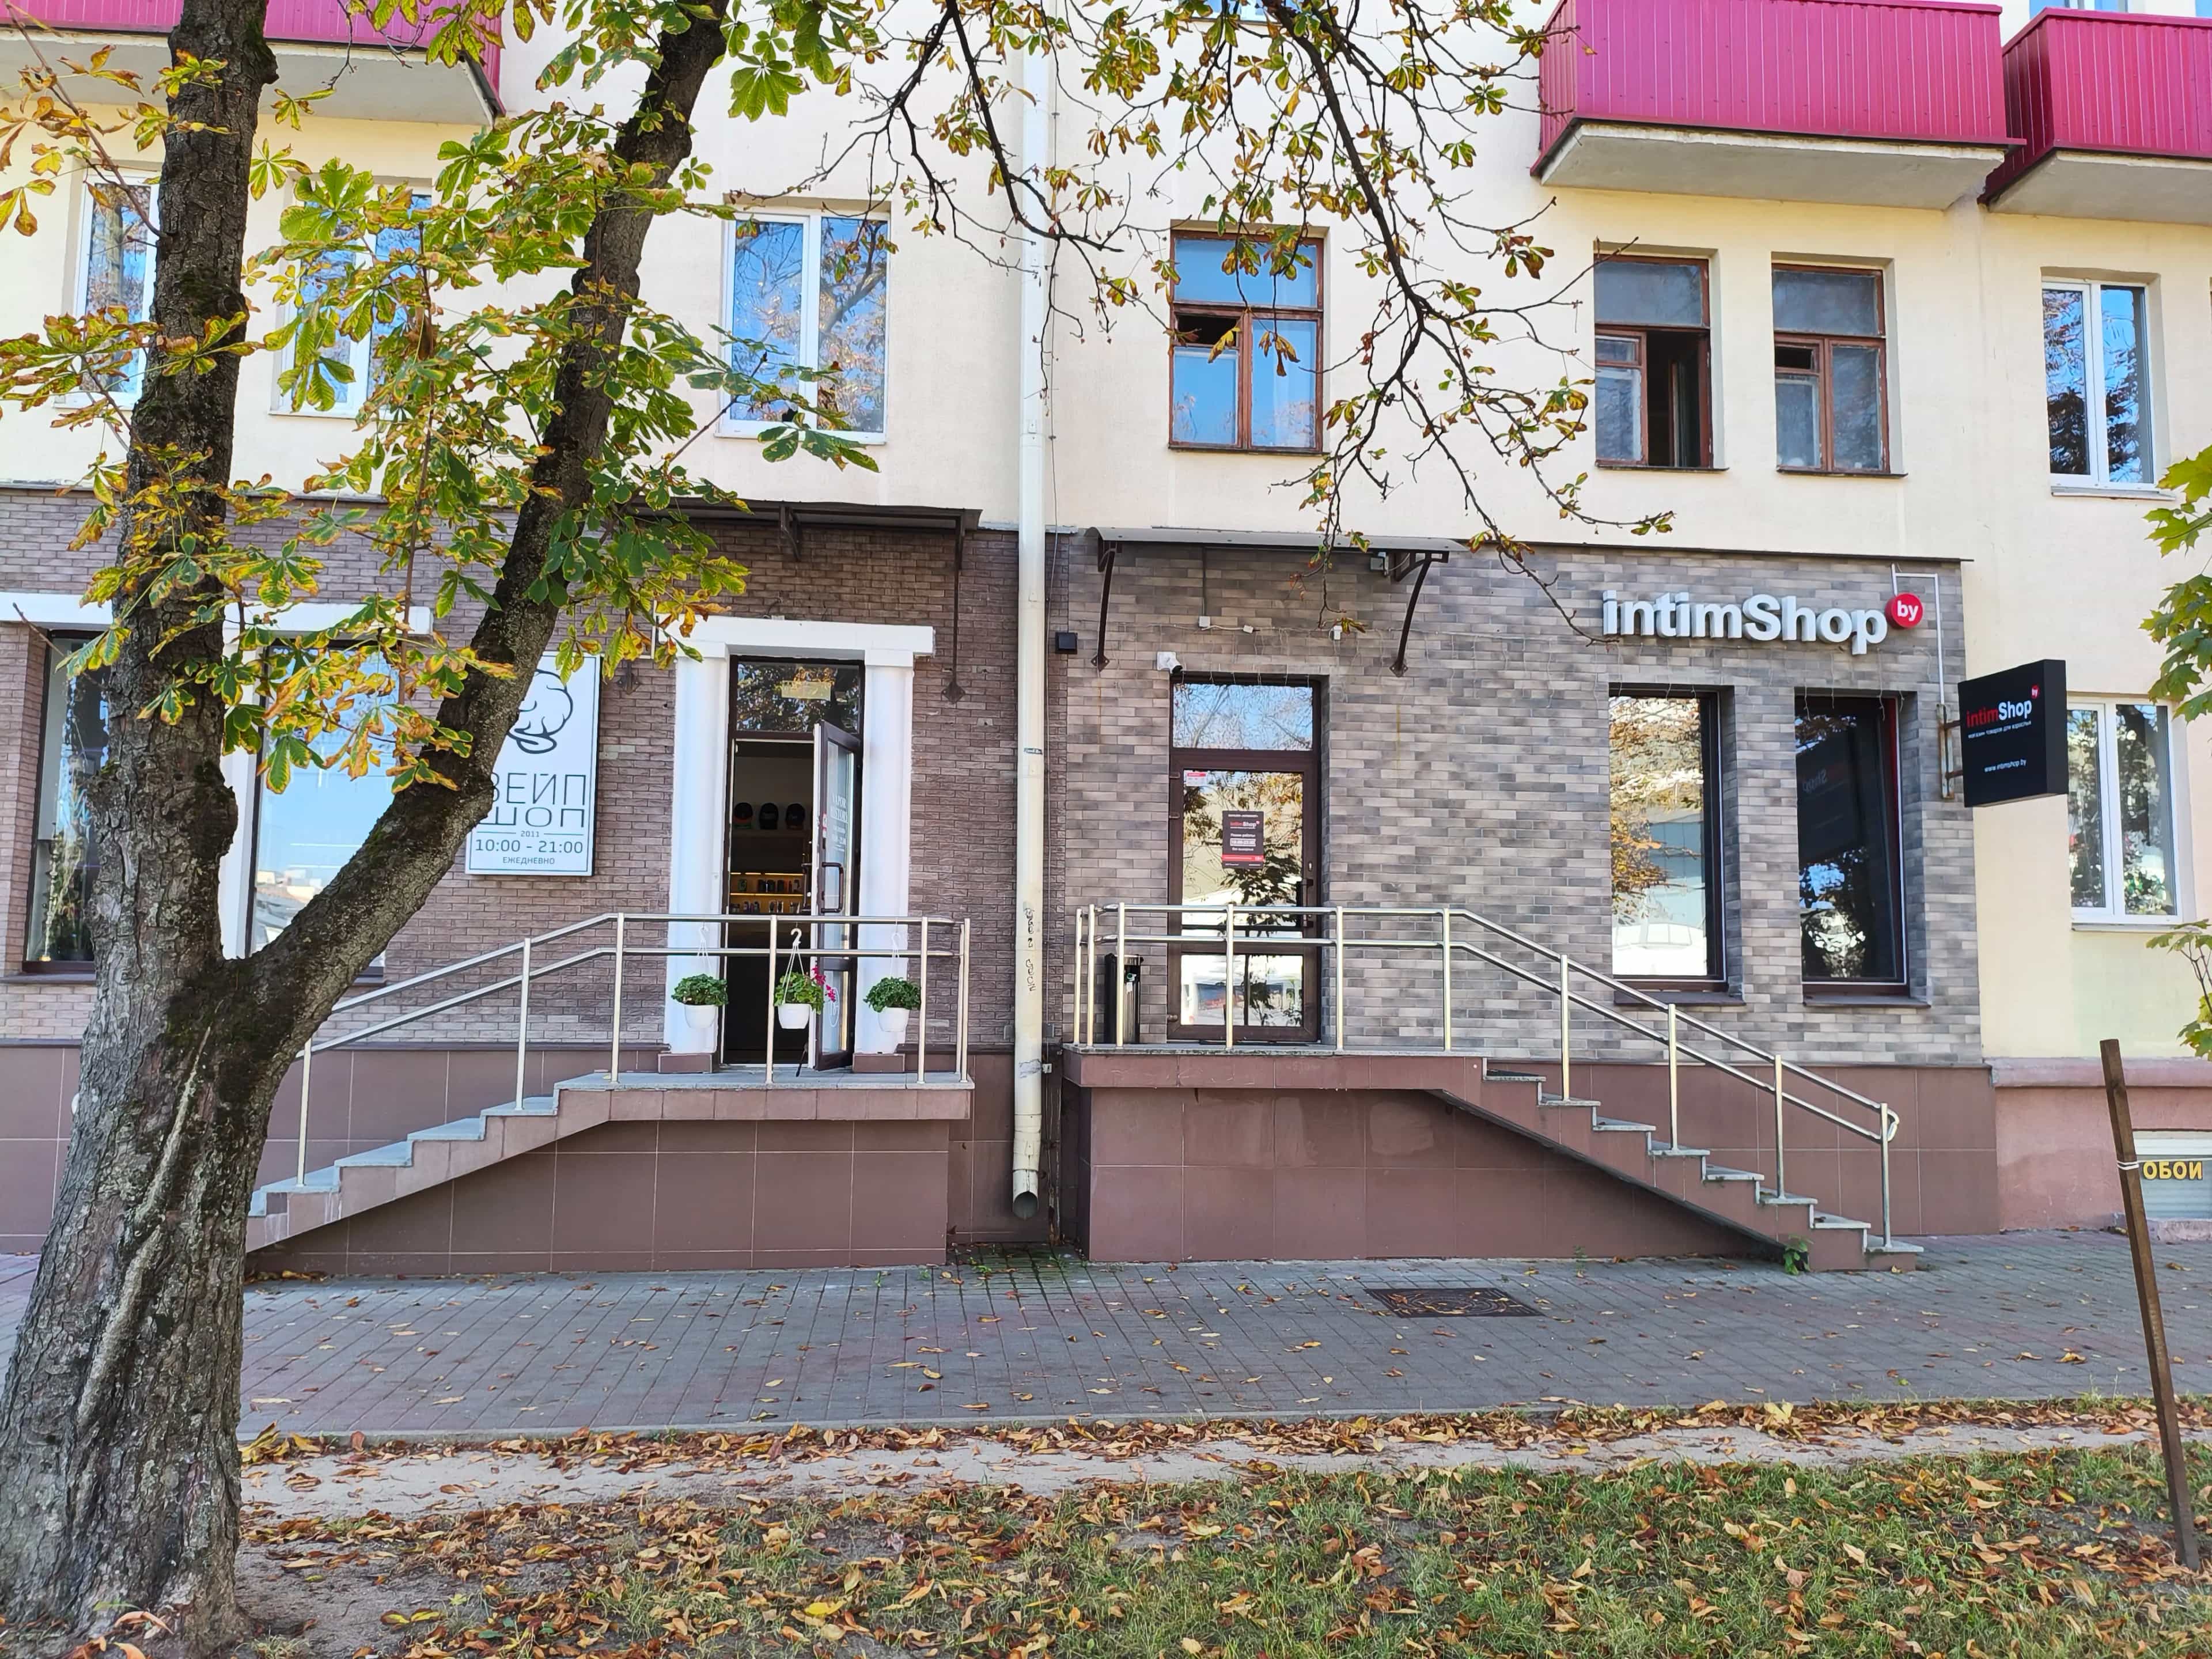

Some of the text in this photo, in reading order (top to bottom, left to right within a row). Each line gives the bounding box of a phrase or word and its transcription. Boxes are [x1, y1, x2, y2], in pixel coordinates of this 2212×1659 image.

[1603, 590, 1919, 654] intimShop by
[1966, 699, 2032, 728] intimShop
[478, 806, 585, 828] ШОП
[475, 839, 521, 852] 10:00
[539, 840, 584, 854] 21:00
[502, 856, 555, 865] ЕЖЕДНЕВНО
[2143, 1161, 2203, 1180] ОБОИ
